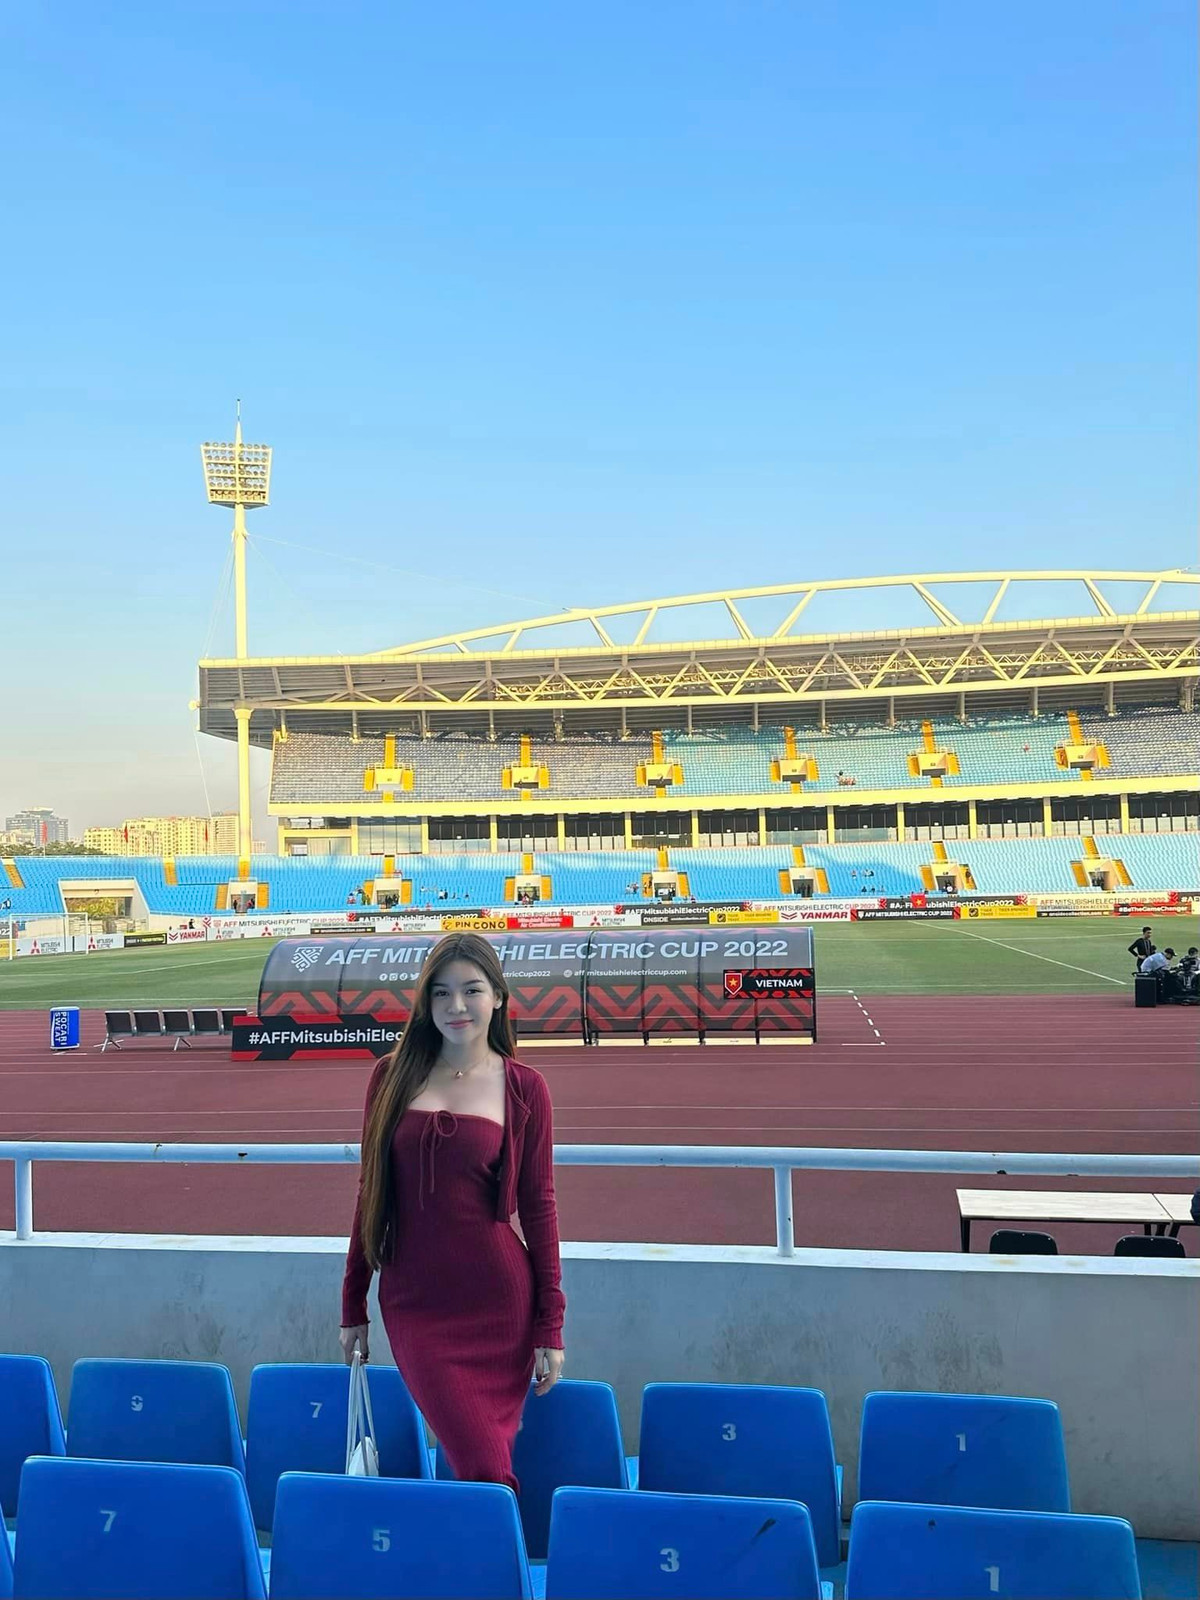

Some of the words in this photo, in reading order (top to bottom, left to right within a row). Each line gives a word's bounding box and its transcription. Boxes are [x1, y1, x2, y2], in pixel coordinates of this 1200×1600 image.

[800, 911, 848, 920] YANMAR
[473, 921, 497, 930] CON
[180, 930, 205, 940] YANMAR
[325, 948, 381, 966] AFF
[381, 944, 526, 964] MITSHI
[527, 942, 655, 961] ELECTRIC
[660, 941, 719, 959] CUP
[723, 940, 789, 957] 2022
[755, 979, 804, 988] VIETNAM
[248, 1028, 404, 1045] #AFFMitsubishiElec
[310, 1402, 322, 1418] 7
[721, 1423, 737, 1441] 3
[955, 1433, 967, 1452] 1
[100, 1509, 117, 1532] 7
[372, 1528, 391, 1552] 5
[659, 1547, 680, 1573] 3
[984, 1565, 1000, 1592] 1
